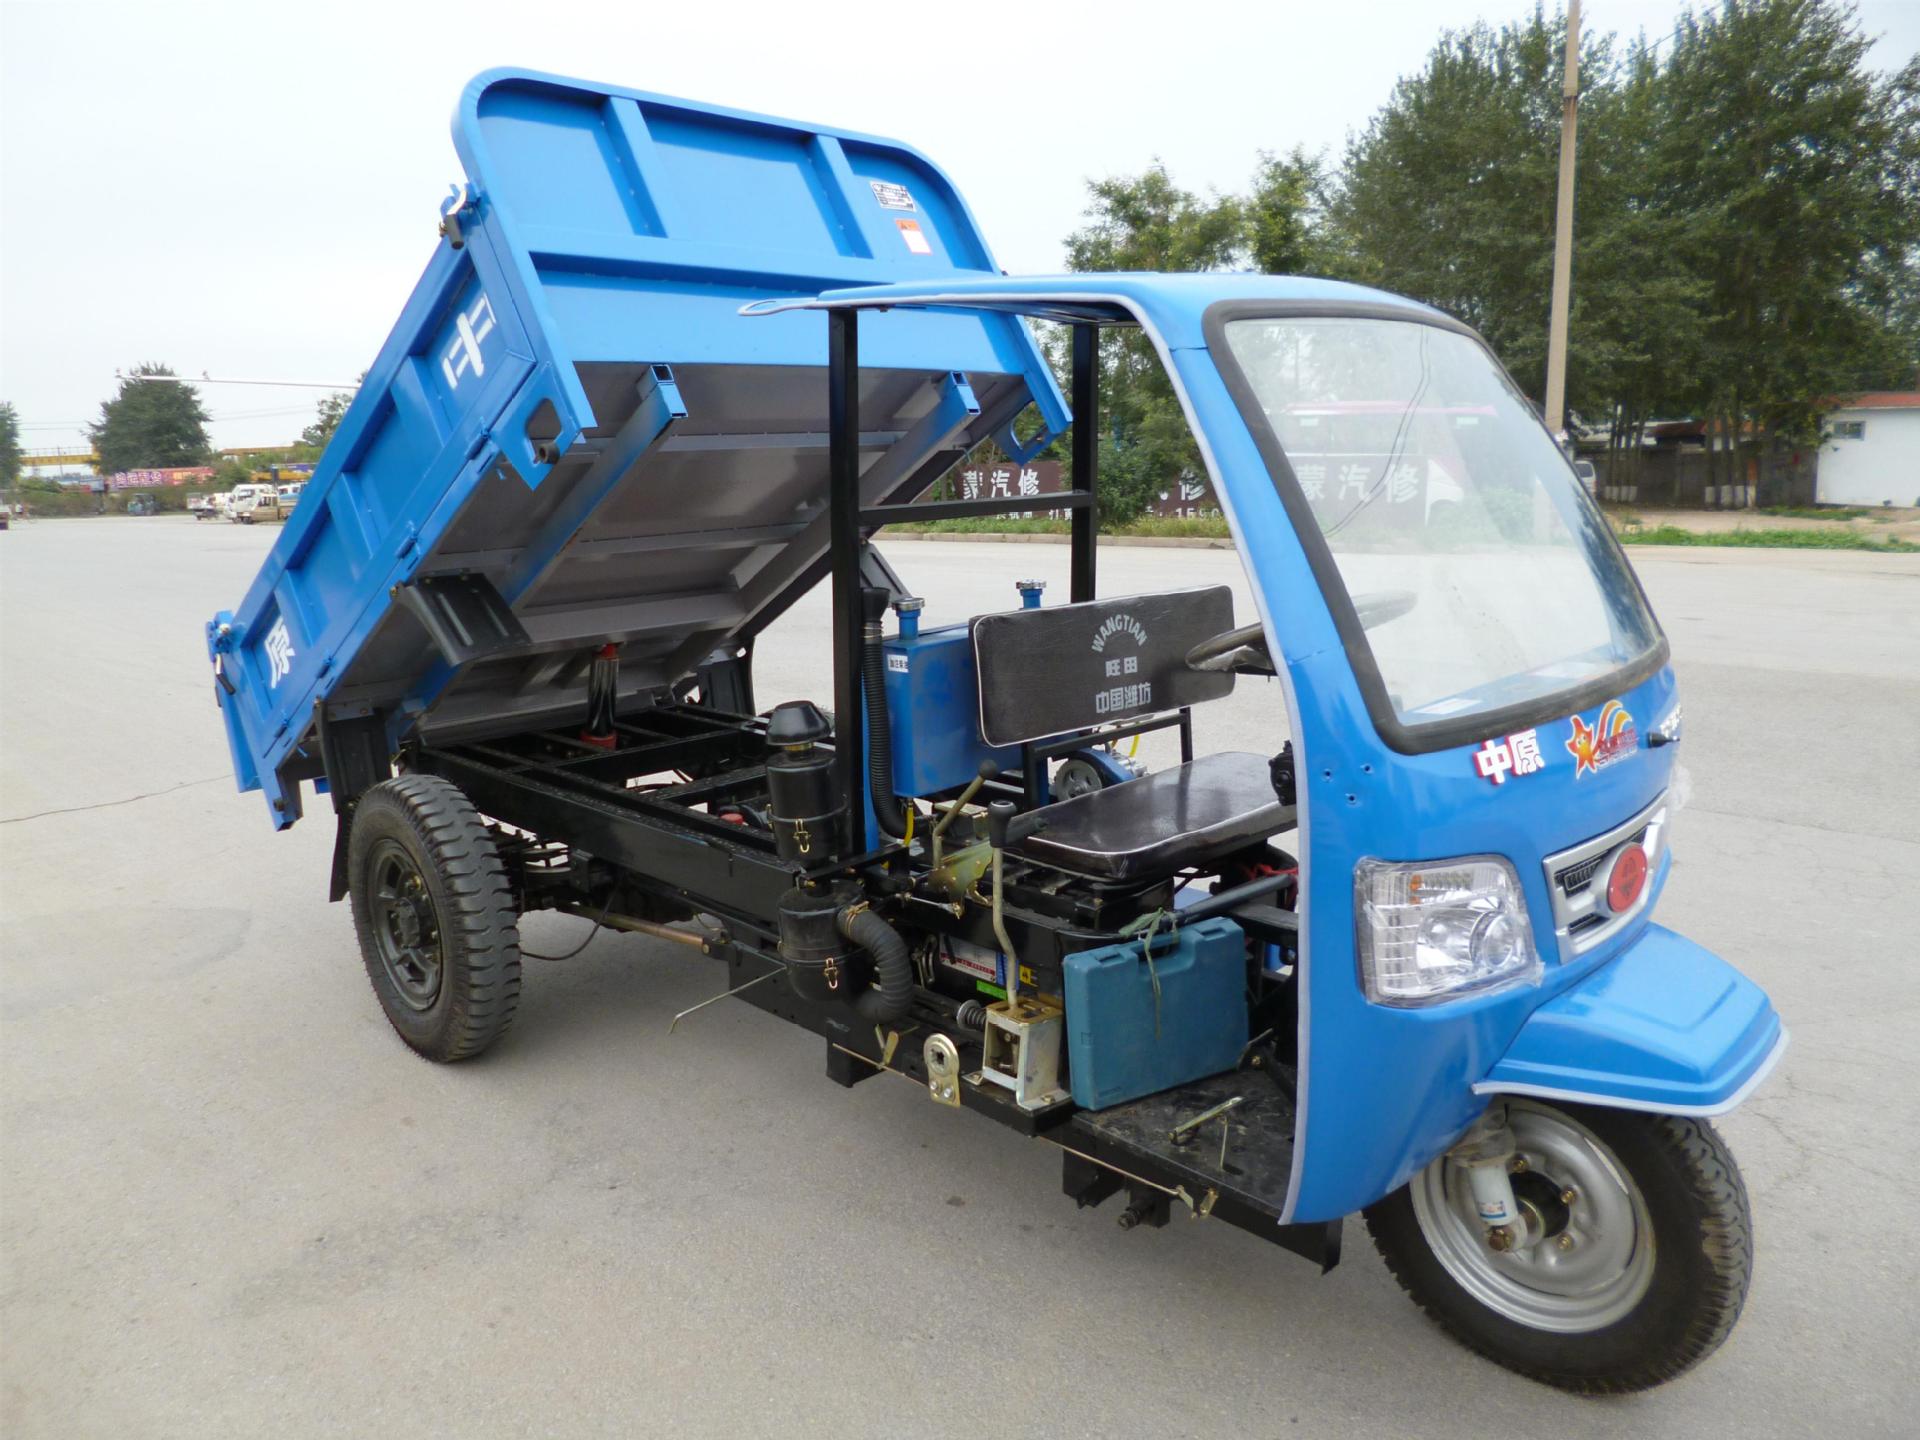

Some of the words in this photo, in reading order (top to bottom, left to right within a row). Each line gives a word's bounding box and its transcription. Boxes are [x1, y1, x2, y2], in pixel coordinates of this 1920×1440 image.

[1091, 614, 1148, 652] WANGTIAN
[1095, 682, 1152, 713] 中国潍坊
[1474, 728, 1545, 784] 中原
